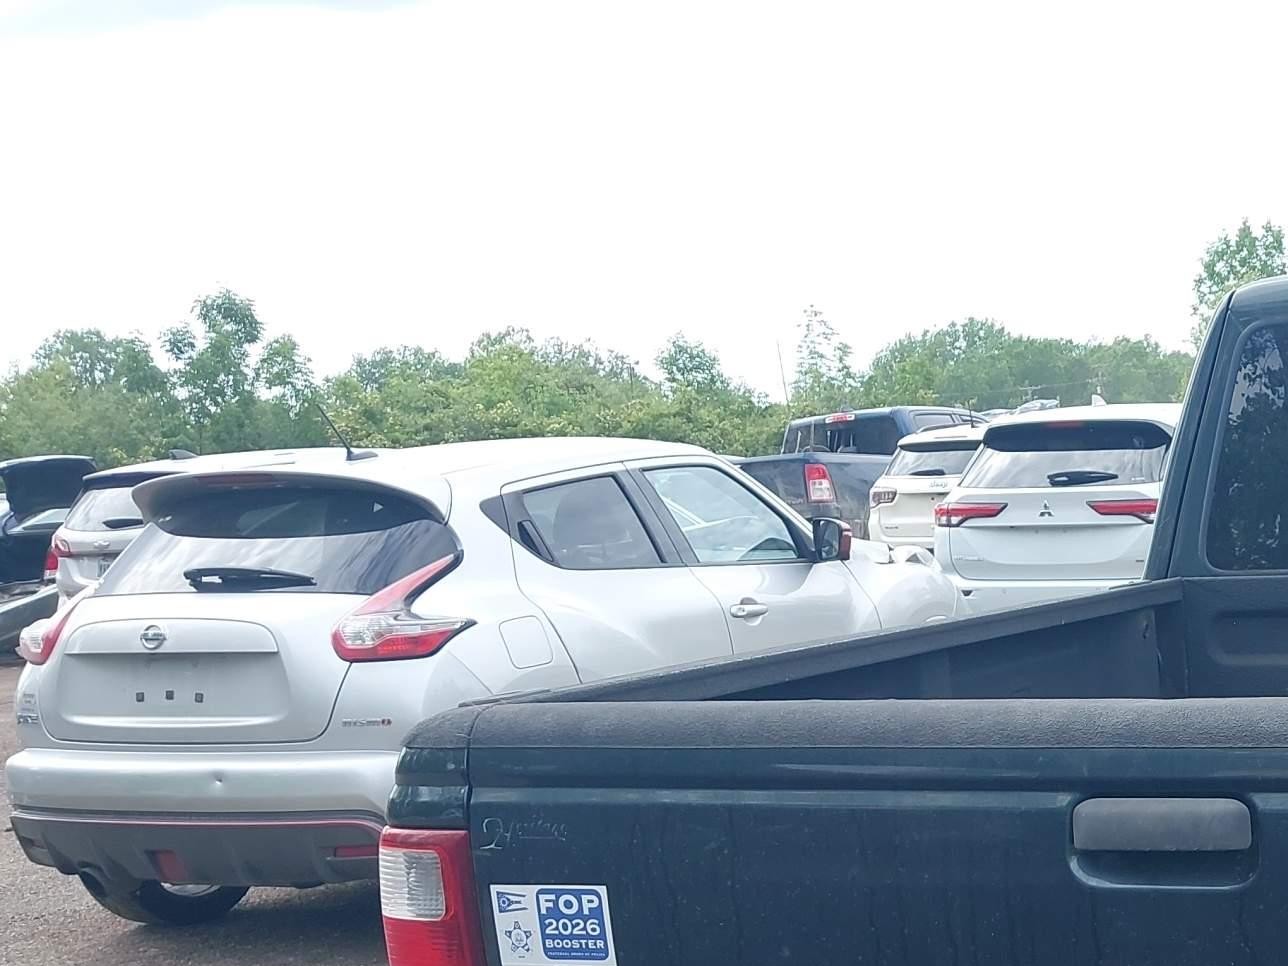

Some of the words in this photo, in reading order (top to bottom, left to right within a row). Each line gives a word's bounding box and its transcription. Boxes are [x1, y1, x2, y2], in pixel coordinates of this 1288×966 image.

[538, 894, 600, 915] FOP
[544, 918, 600, 936] 2026
[545, 939, 605, 949] BOOSTER
